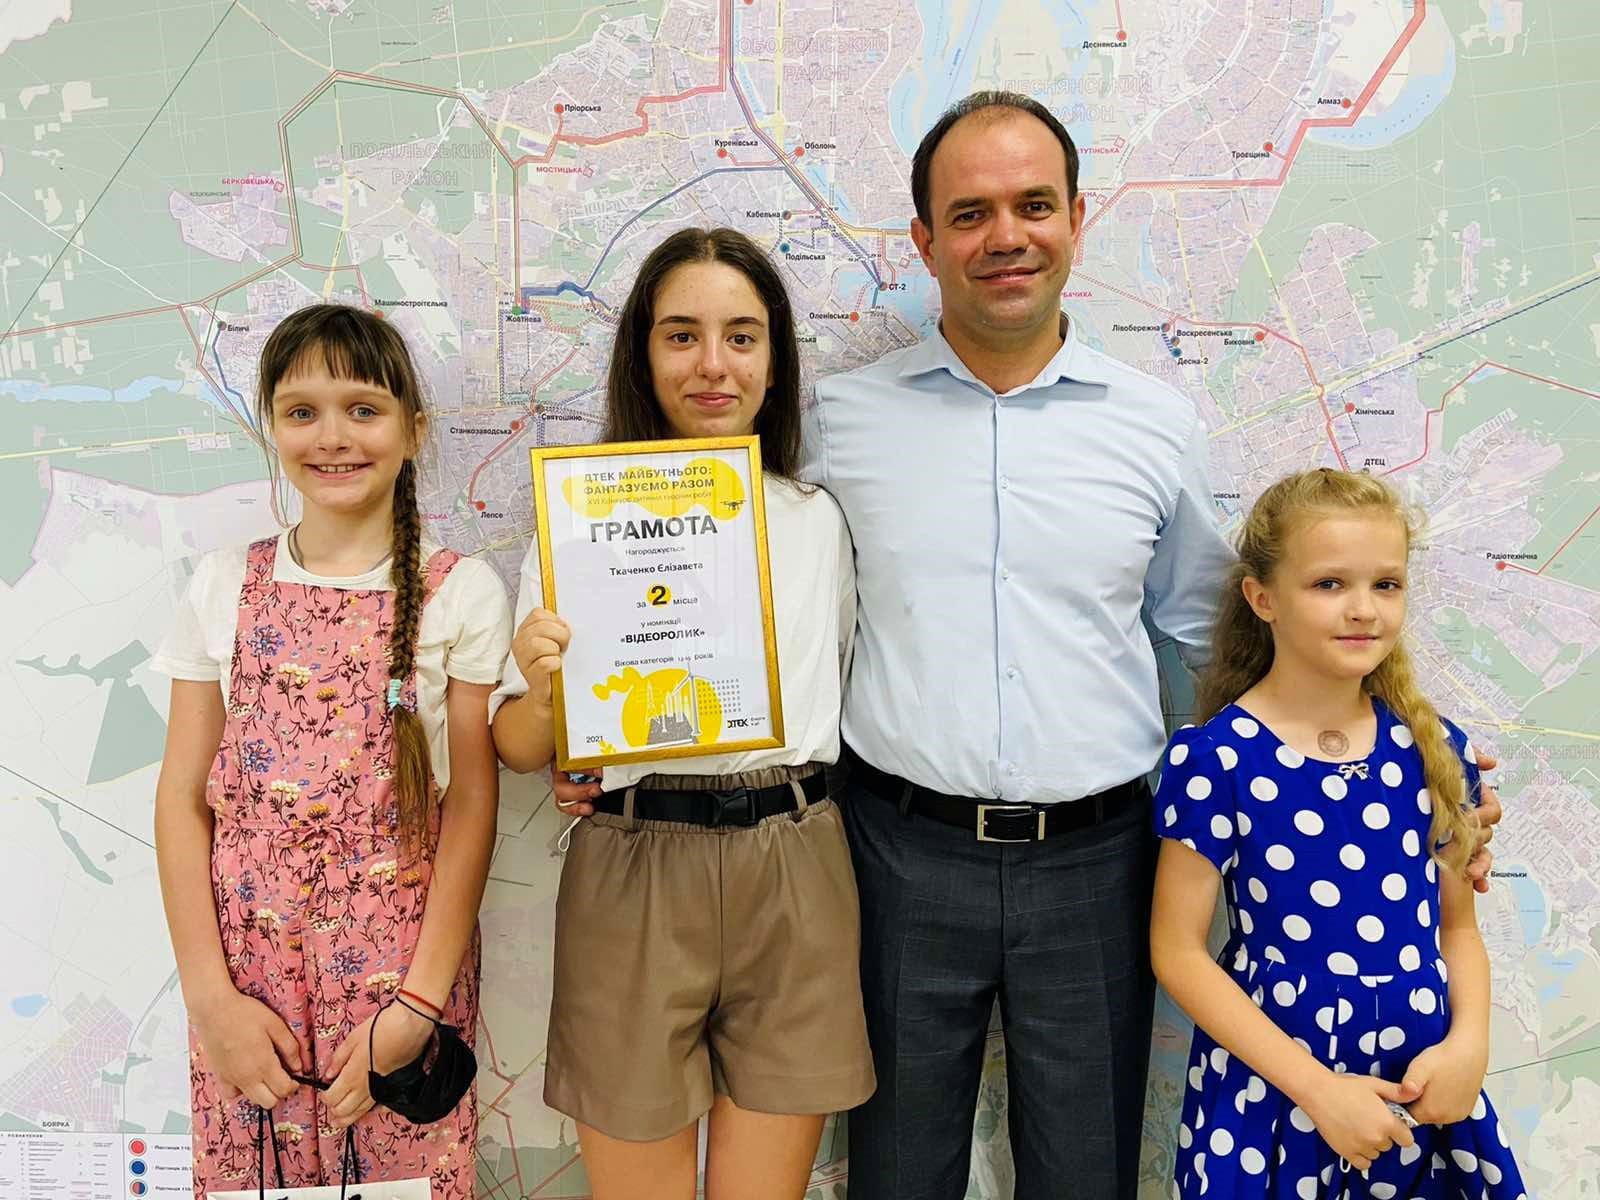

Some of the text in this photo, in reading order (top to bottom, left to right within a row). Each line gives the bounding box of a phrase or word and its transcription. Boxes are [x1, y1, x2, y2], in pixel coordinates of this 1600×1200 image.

[1082, 41, 1127, 49] Деснянська
[1317, 97, 1341, 106] Алмаз
[564, 103, 602, 114] Пріорська
[714, 139, 758, 149] Куренівська
[804, 141, 836, 150] Оболонь
[1231, 150, 1271, 160] Троєщина
[746, 210, 781, 219] Кабельна
[785, 252, 826, 262] Подільська
[889, 283, 906, 291] СТ-2
[809, 312, 850, 320] Оленівська
[1112, 323, 1161, 332] Лівобережна
[1176, 329, 1233, 339] Воскресенська
[1177, 357, 1209, 366] Десна-2
[450, 427, 512, 435] Станкозаводська
[1364, 458, 1386, 468] ДТЕЦ
[585, 466, 712, 484] ДТЕК МАЙБУТНЬОГО:
[584, 478, 715, 496] ФАНТАЗУЄМО РАЗОМ
[481, 511, 504, 519] Лепсе
[589, 514, 718, 543] ГРАМОТА
[625, 545, 686, 558] Нагороджується
[1486, 552, 1538, 561] Радіотехнічна
[609, 561, 704, 577] Ткаченко Єлізавета
[636, 601, 647, 609] за
[650, 585, 668, 606] 2
[620, 628, 706, 644] «ВІДЕОРОЛИК»
[614, 659, 639, 668] Вікова
[640, 655, 675, 667] категорія
[694, 652, 714, 663] років
[586, 735, 604, 744] 2021
[1490, 870, 1528, 878] Вишеньки
